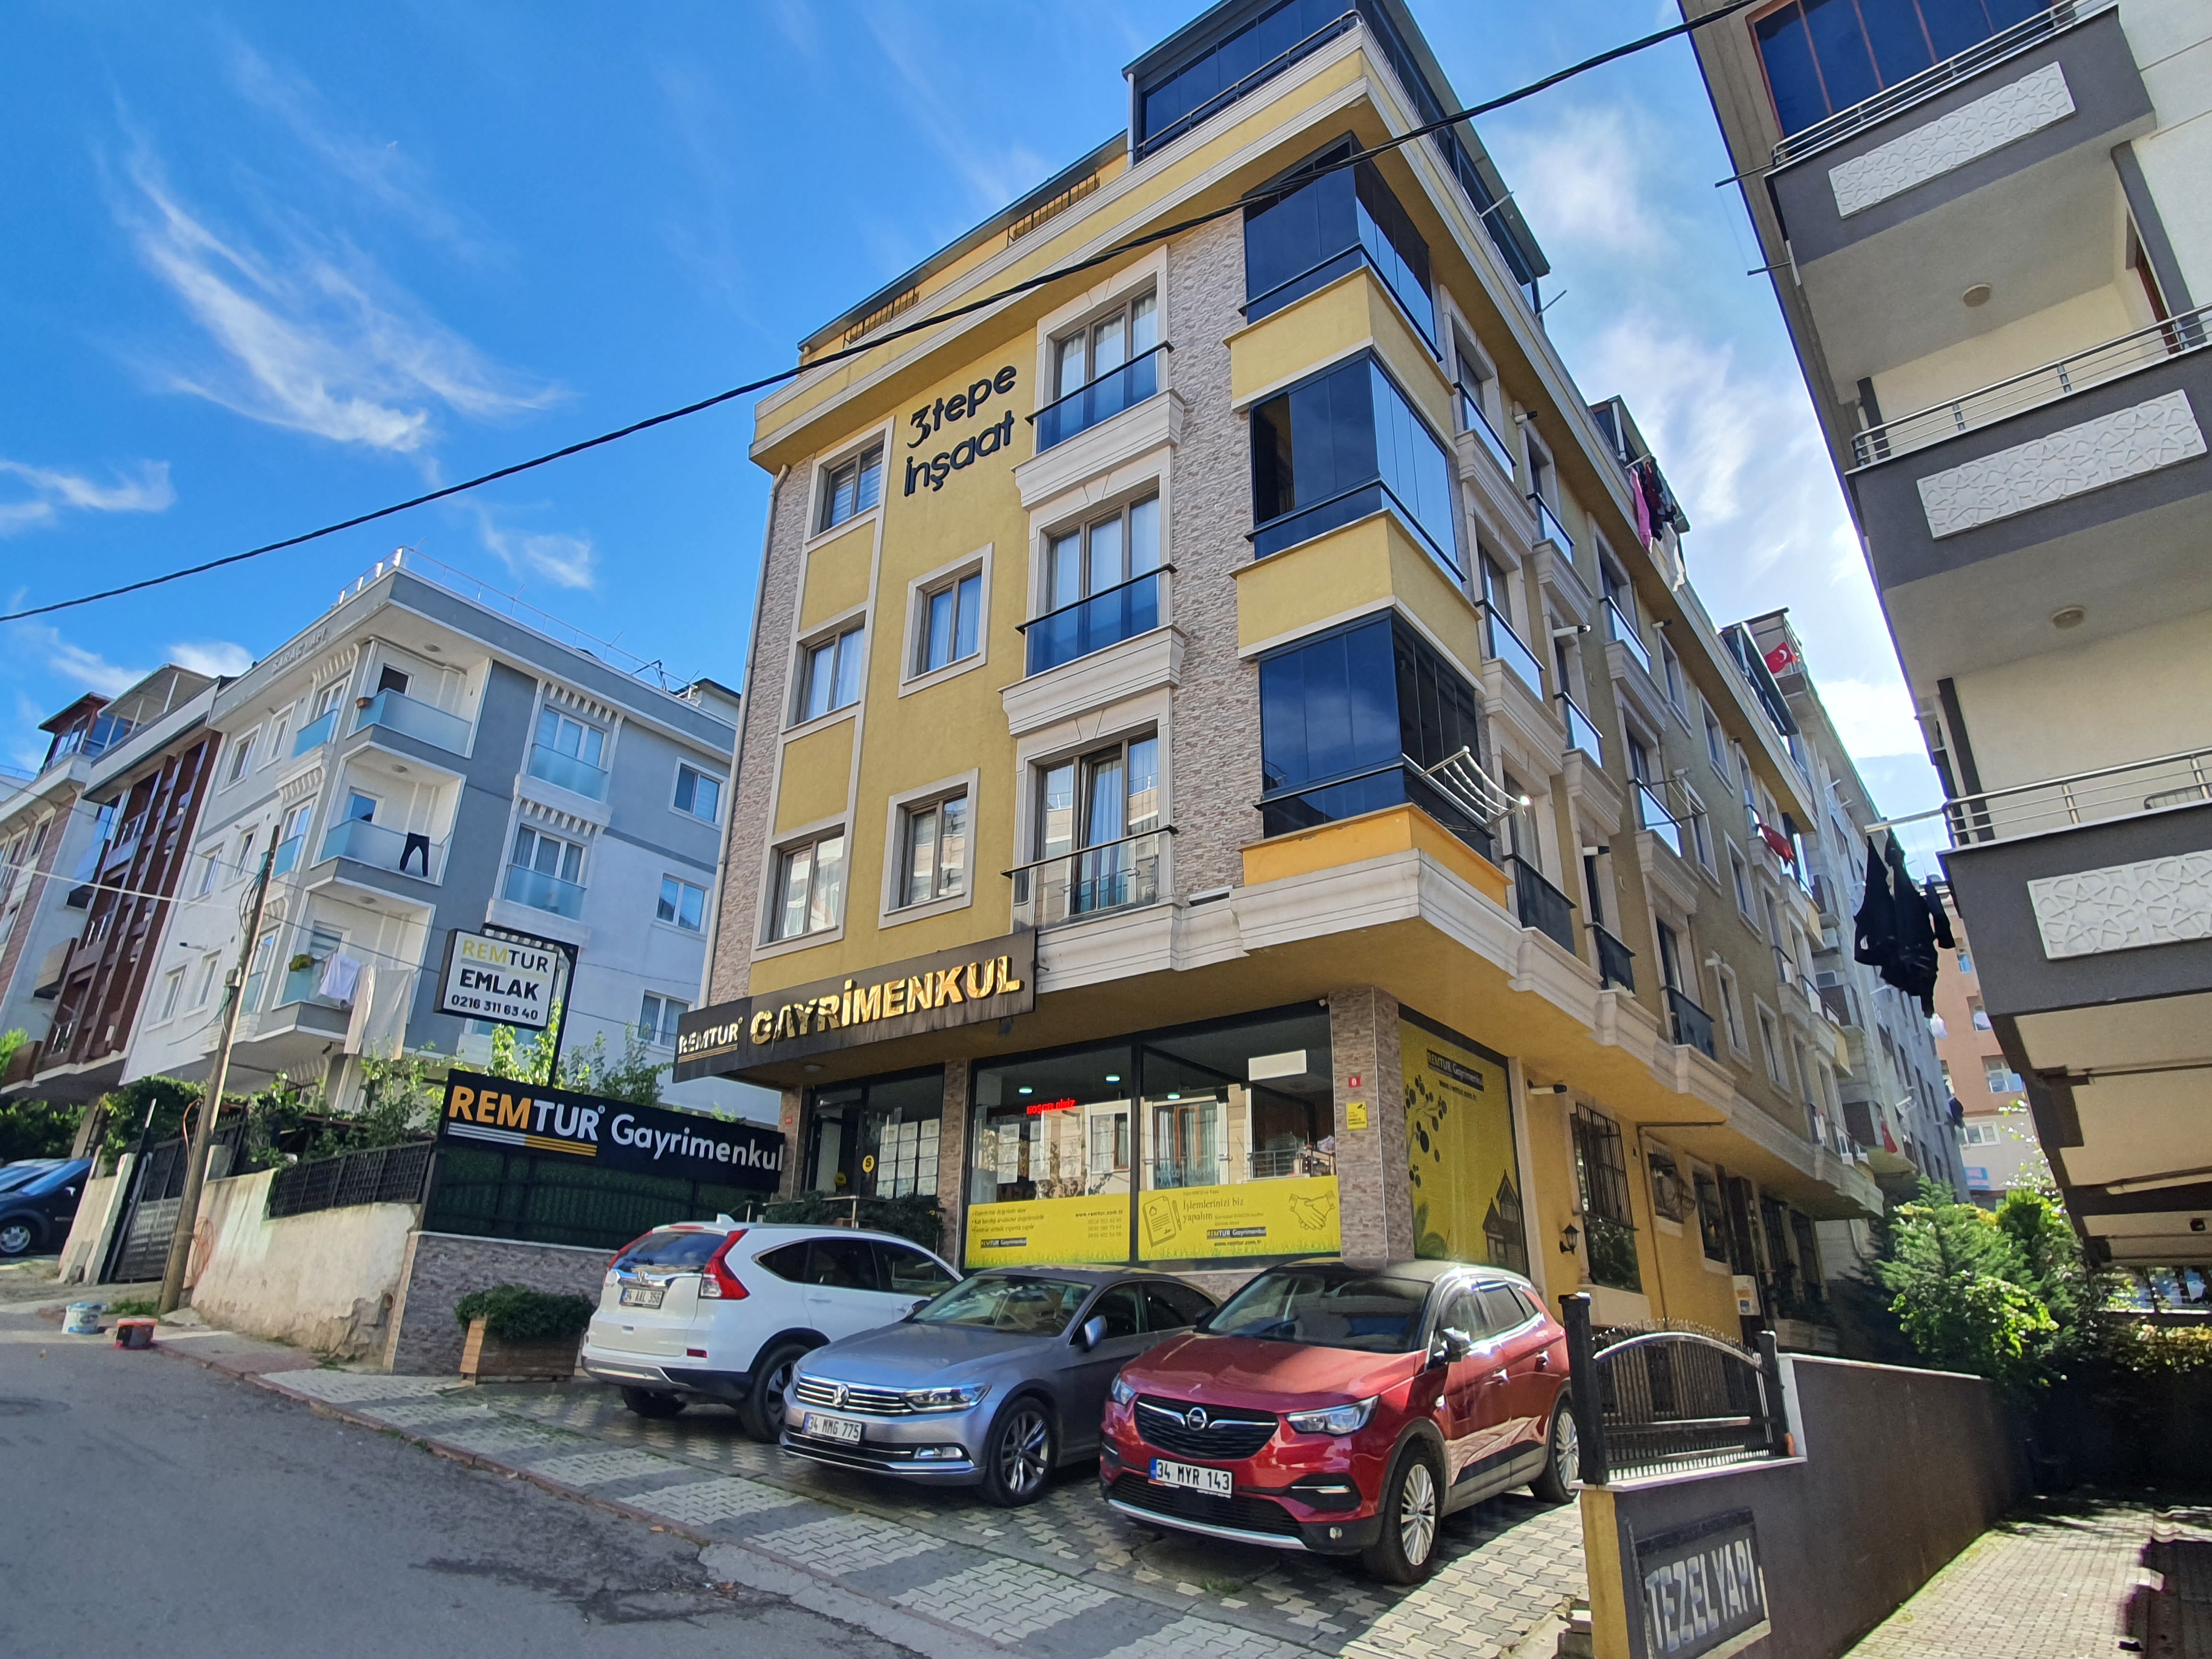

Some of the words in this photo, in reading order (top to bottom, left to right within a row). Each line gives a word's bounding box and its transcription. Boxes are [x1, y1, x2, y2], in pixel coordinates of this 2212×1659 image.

[462, 939, 548, 973] REMTUR
[459, 968, 539, 1001] EMLAK
[451, 994, 481, 1009] 0216
[483, 1000, 501, 1013] 311
[522, 1009, 539, 1020] 40
[678, 1022, 738, 1055] REMTUR
[750, 954, 1022, 1046] GAYRİMENKUL
[448, 1085, 599, 1142] REMTUR
[611, 1113, 784, 1172] Gayrimenkul
[1232, 1197, 1244, 1206] biz
[1183, 1211, 1213, 1224] yapalım
[808, 1416, 818, 1431] 34
[842, 1422, 860, 1439] 775
[1157, 1462, 1170, 1480] 34
[1177, 1465, 1200, 1486] MYR
[1207, 1471, 1229, 1491] 143
[1645, 1553, 1719, 1653] TEZEL
[1711, 1538, 1759, 1621] YAPI
